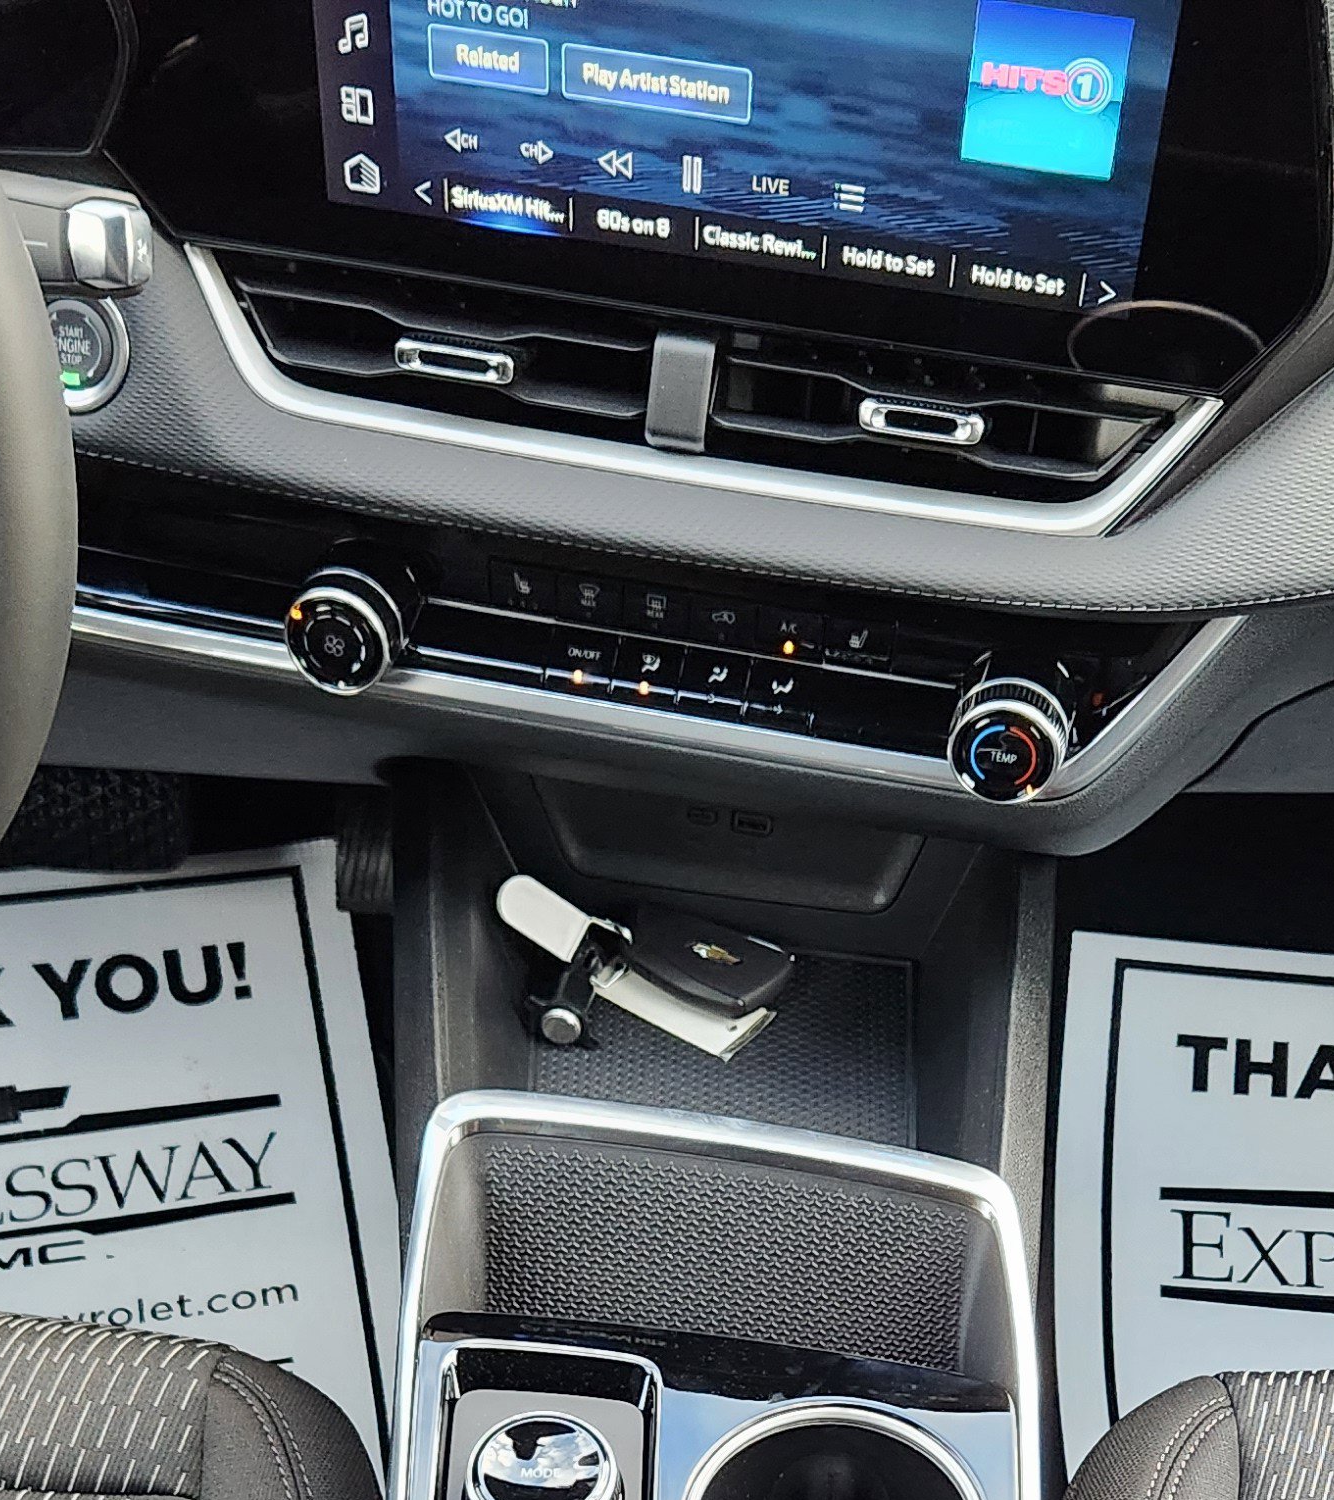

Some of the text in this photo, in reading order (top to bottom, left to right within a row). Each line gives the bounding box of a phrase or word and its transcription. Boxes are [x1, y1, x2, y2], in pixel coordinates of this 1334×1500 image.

[427, 0, 529, 30] HOT TO GO!
[456, 43, 520, 73] Related
[582, 62, 730, 105] Play Artist Station
[981, 61, 1068, 97] HITS
[752, 175, 790, 196] LIVE
[450, 185, 524, 217] SiriusXM
[596, 208, 670, 239] 80s on 8
[702, 225, 760, 252] Classic
[842, 245, 936, 278] Hold to Set
[971, 263, 1067, 297] Hold to Set
[58, 338, 91, 356] NGINE
[59, 326, 83, 339] START
[60, 354, 82, 365] STOP
[780, 621, 798, 634] A/C
[568, 646, 602, 661] ON/OFF
[991, 751, 1018, 764] TEMP
[33, 942, 254, 1024] YOU!
